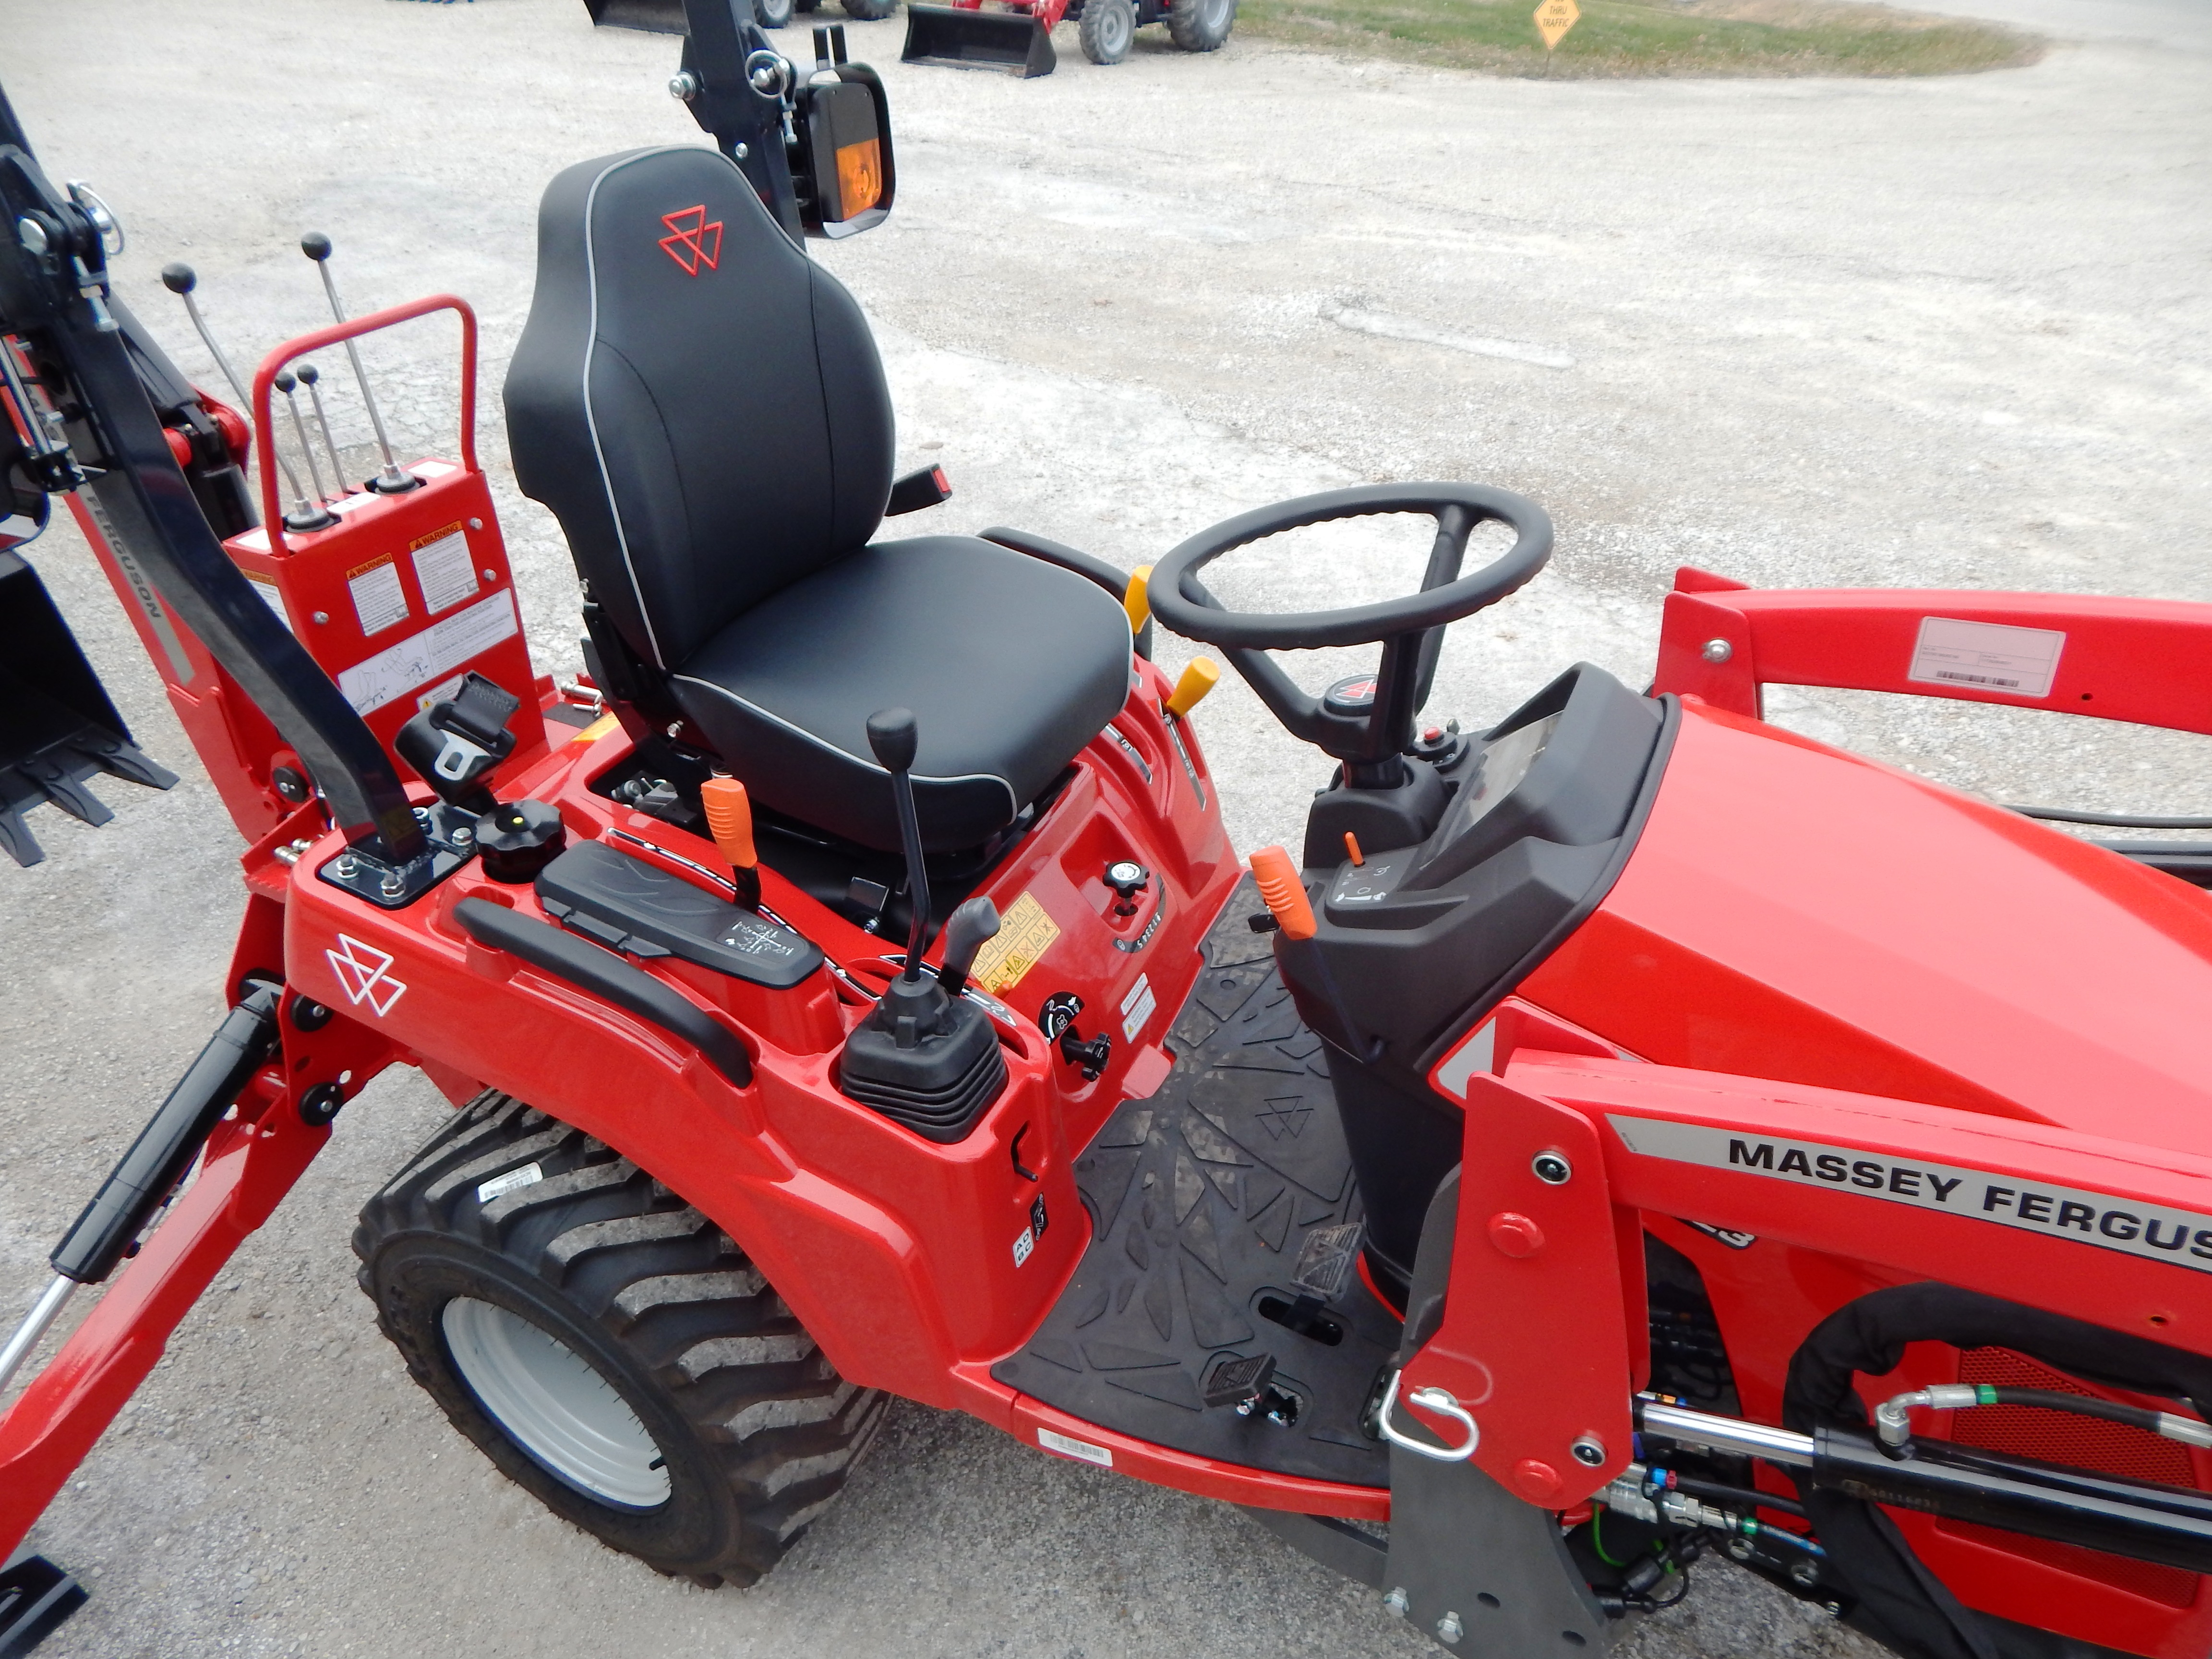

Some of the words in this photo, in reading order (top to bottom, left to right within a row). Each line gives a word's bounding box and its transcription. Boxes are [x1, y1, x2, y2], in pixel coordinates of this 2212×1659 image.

[1550, 6, 1567, 14] THRU
[1543, 18, 1569, 27] TRAFFIC
[423, 523, 458, 544] WARNING
[87, 495, 161, 618] FERGUSON
[356, 554, 392, 575] WARNING
[1729, 1139, 1963, 1202] MASSEY
